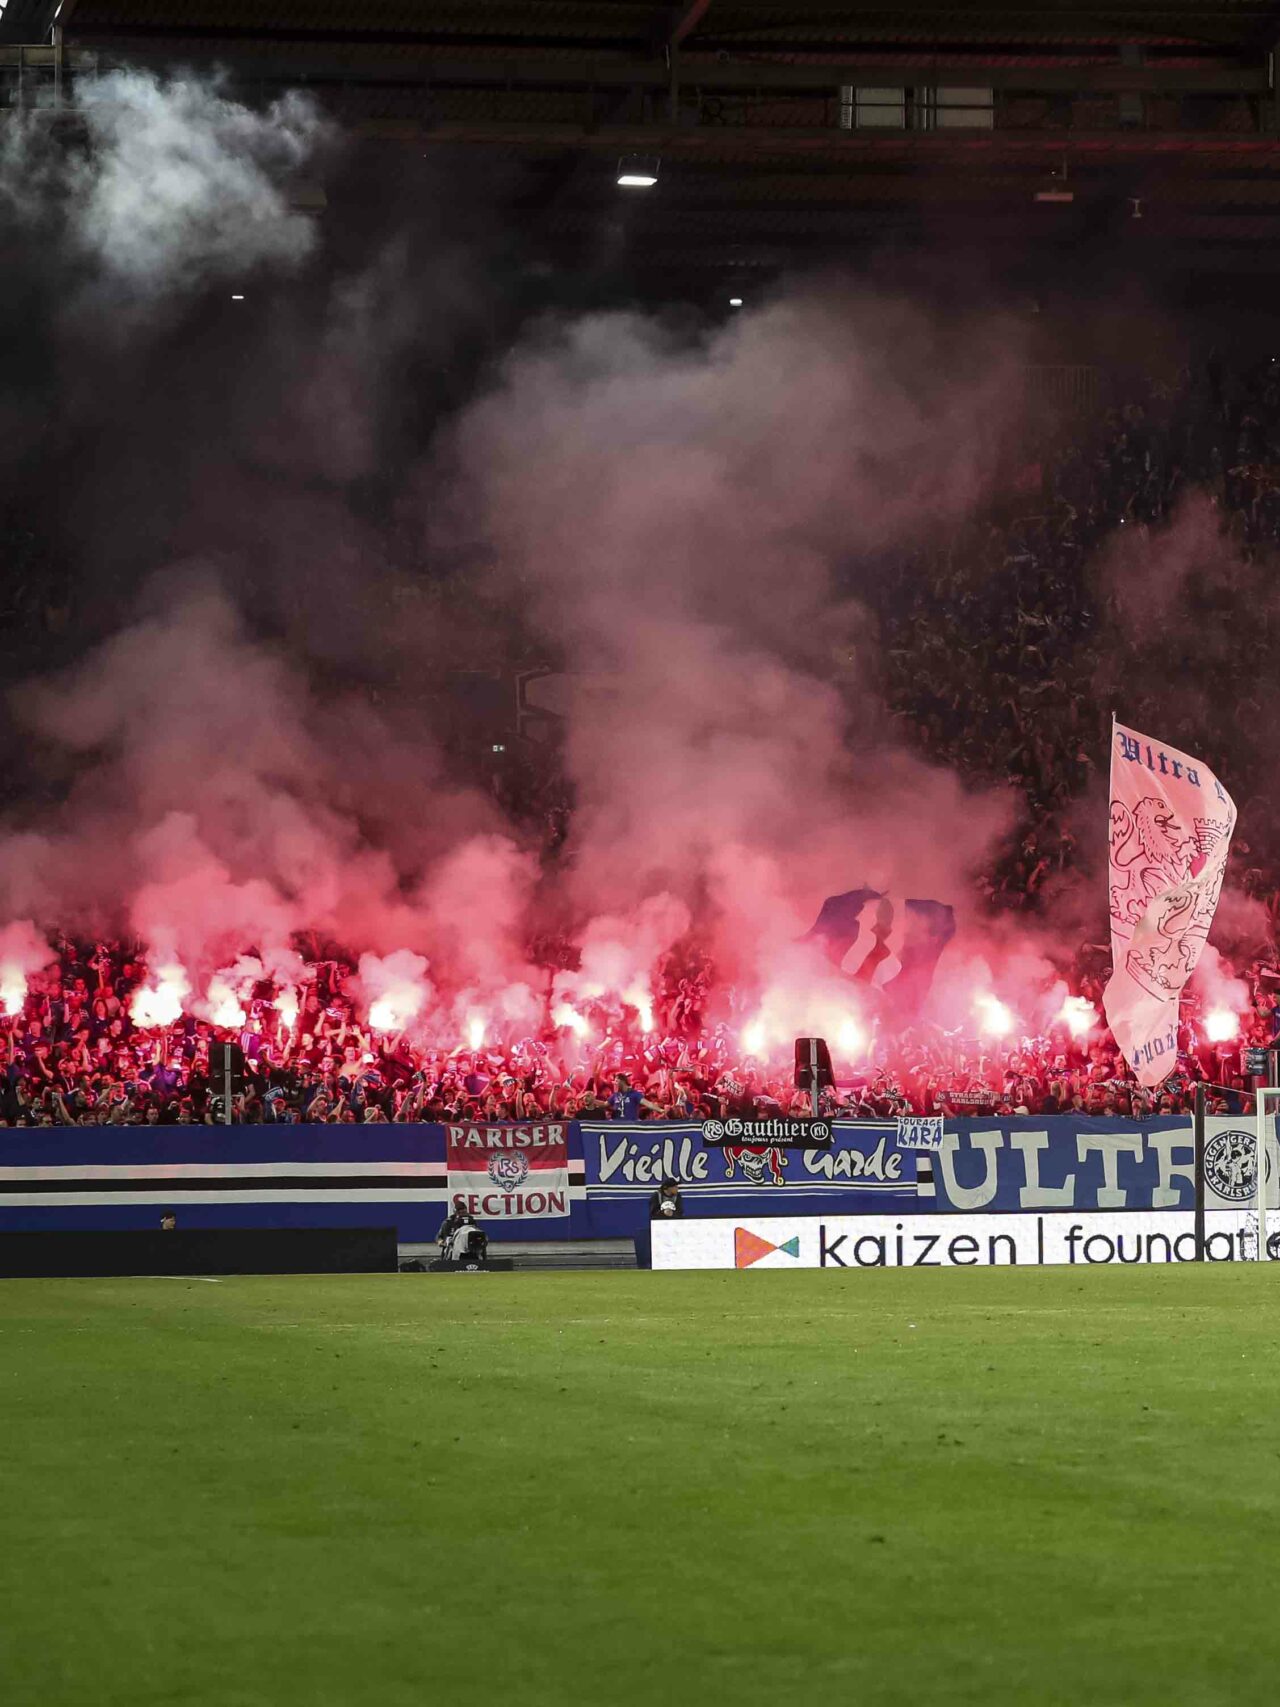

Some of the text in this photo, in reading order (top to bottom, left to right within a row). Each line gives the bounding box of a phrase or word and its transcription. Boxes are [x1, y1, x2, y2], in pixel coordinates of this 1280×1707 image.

[1117, 732, 1201, 787] Ultra
[724, 1118, 808, 1136] Gauthier
[899, 1117, 942, 1126] COURAGE
[449, 1124, 564, 1148] PARISER
[898, 1126, 942, 1147] KARA
[599, 1134, 902, 1182] Vieille Garde
[820, 1224, 1016, 1267] kaizen
